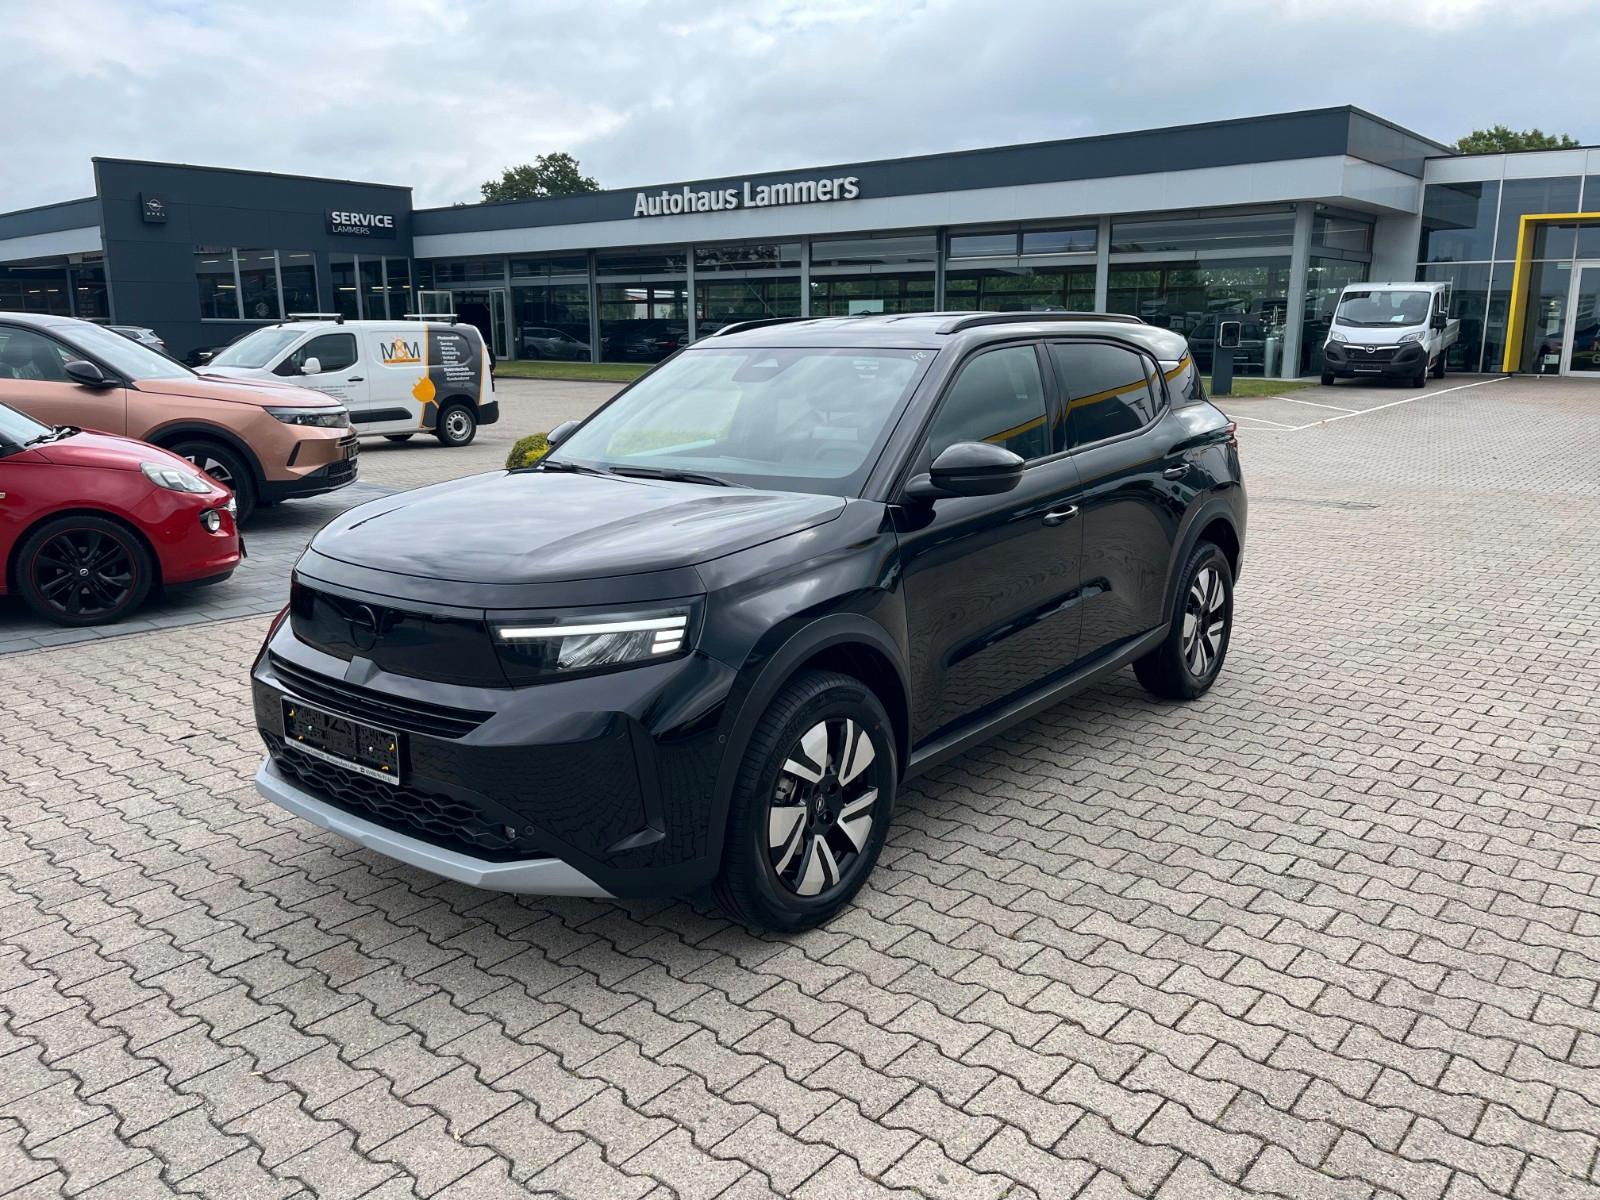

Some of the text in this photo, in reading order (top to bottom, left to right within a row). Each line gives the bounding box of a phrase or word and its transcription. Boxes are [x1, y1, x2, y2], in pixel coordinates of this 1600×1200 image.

[633, 176, 861, 217] Autohaus Lammers
[331, 211, 394, 228] SERVICE
[332, 225, 370, 235] LAMMERS
[380, 338, 421, 360] M&M
